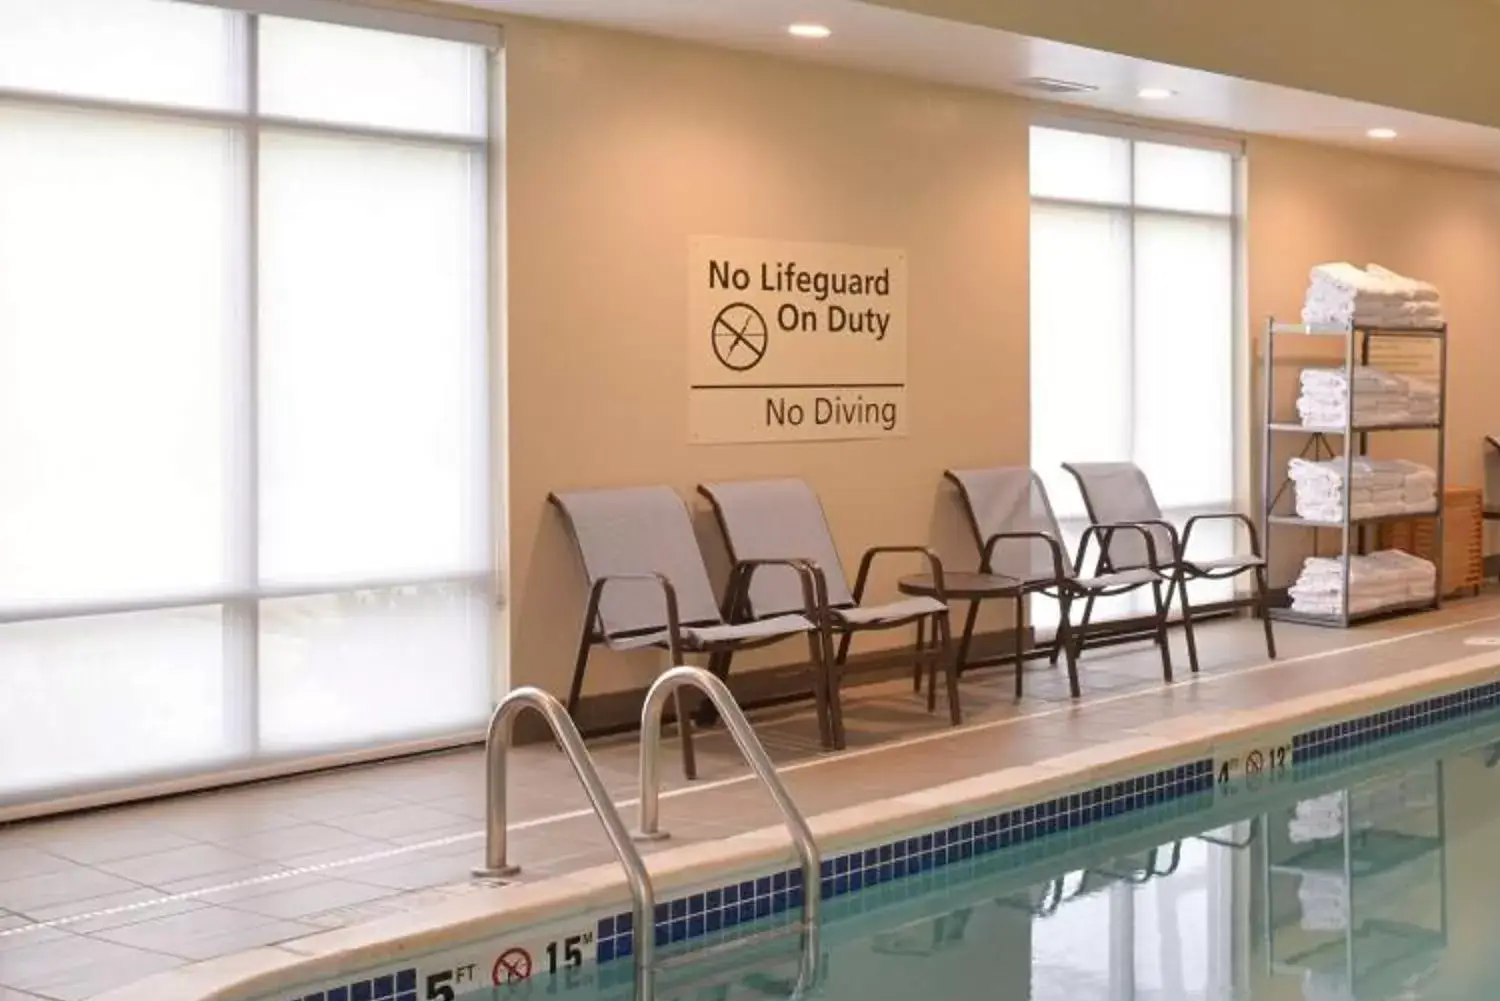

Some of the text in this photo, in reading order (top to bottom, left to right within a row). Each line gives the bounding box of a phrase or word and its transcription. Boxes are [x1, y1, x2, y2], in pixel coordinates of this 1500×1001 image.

[709, 259, 890, 301] No Lifeguard
[777, 303, 891, 341] On Duty
[766, 396, 897, 430] No Diving
